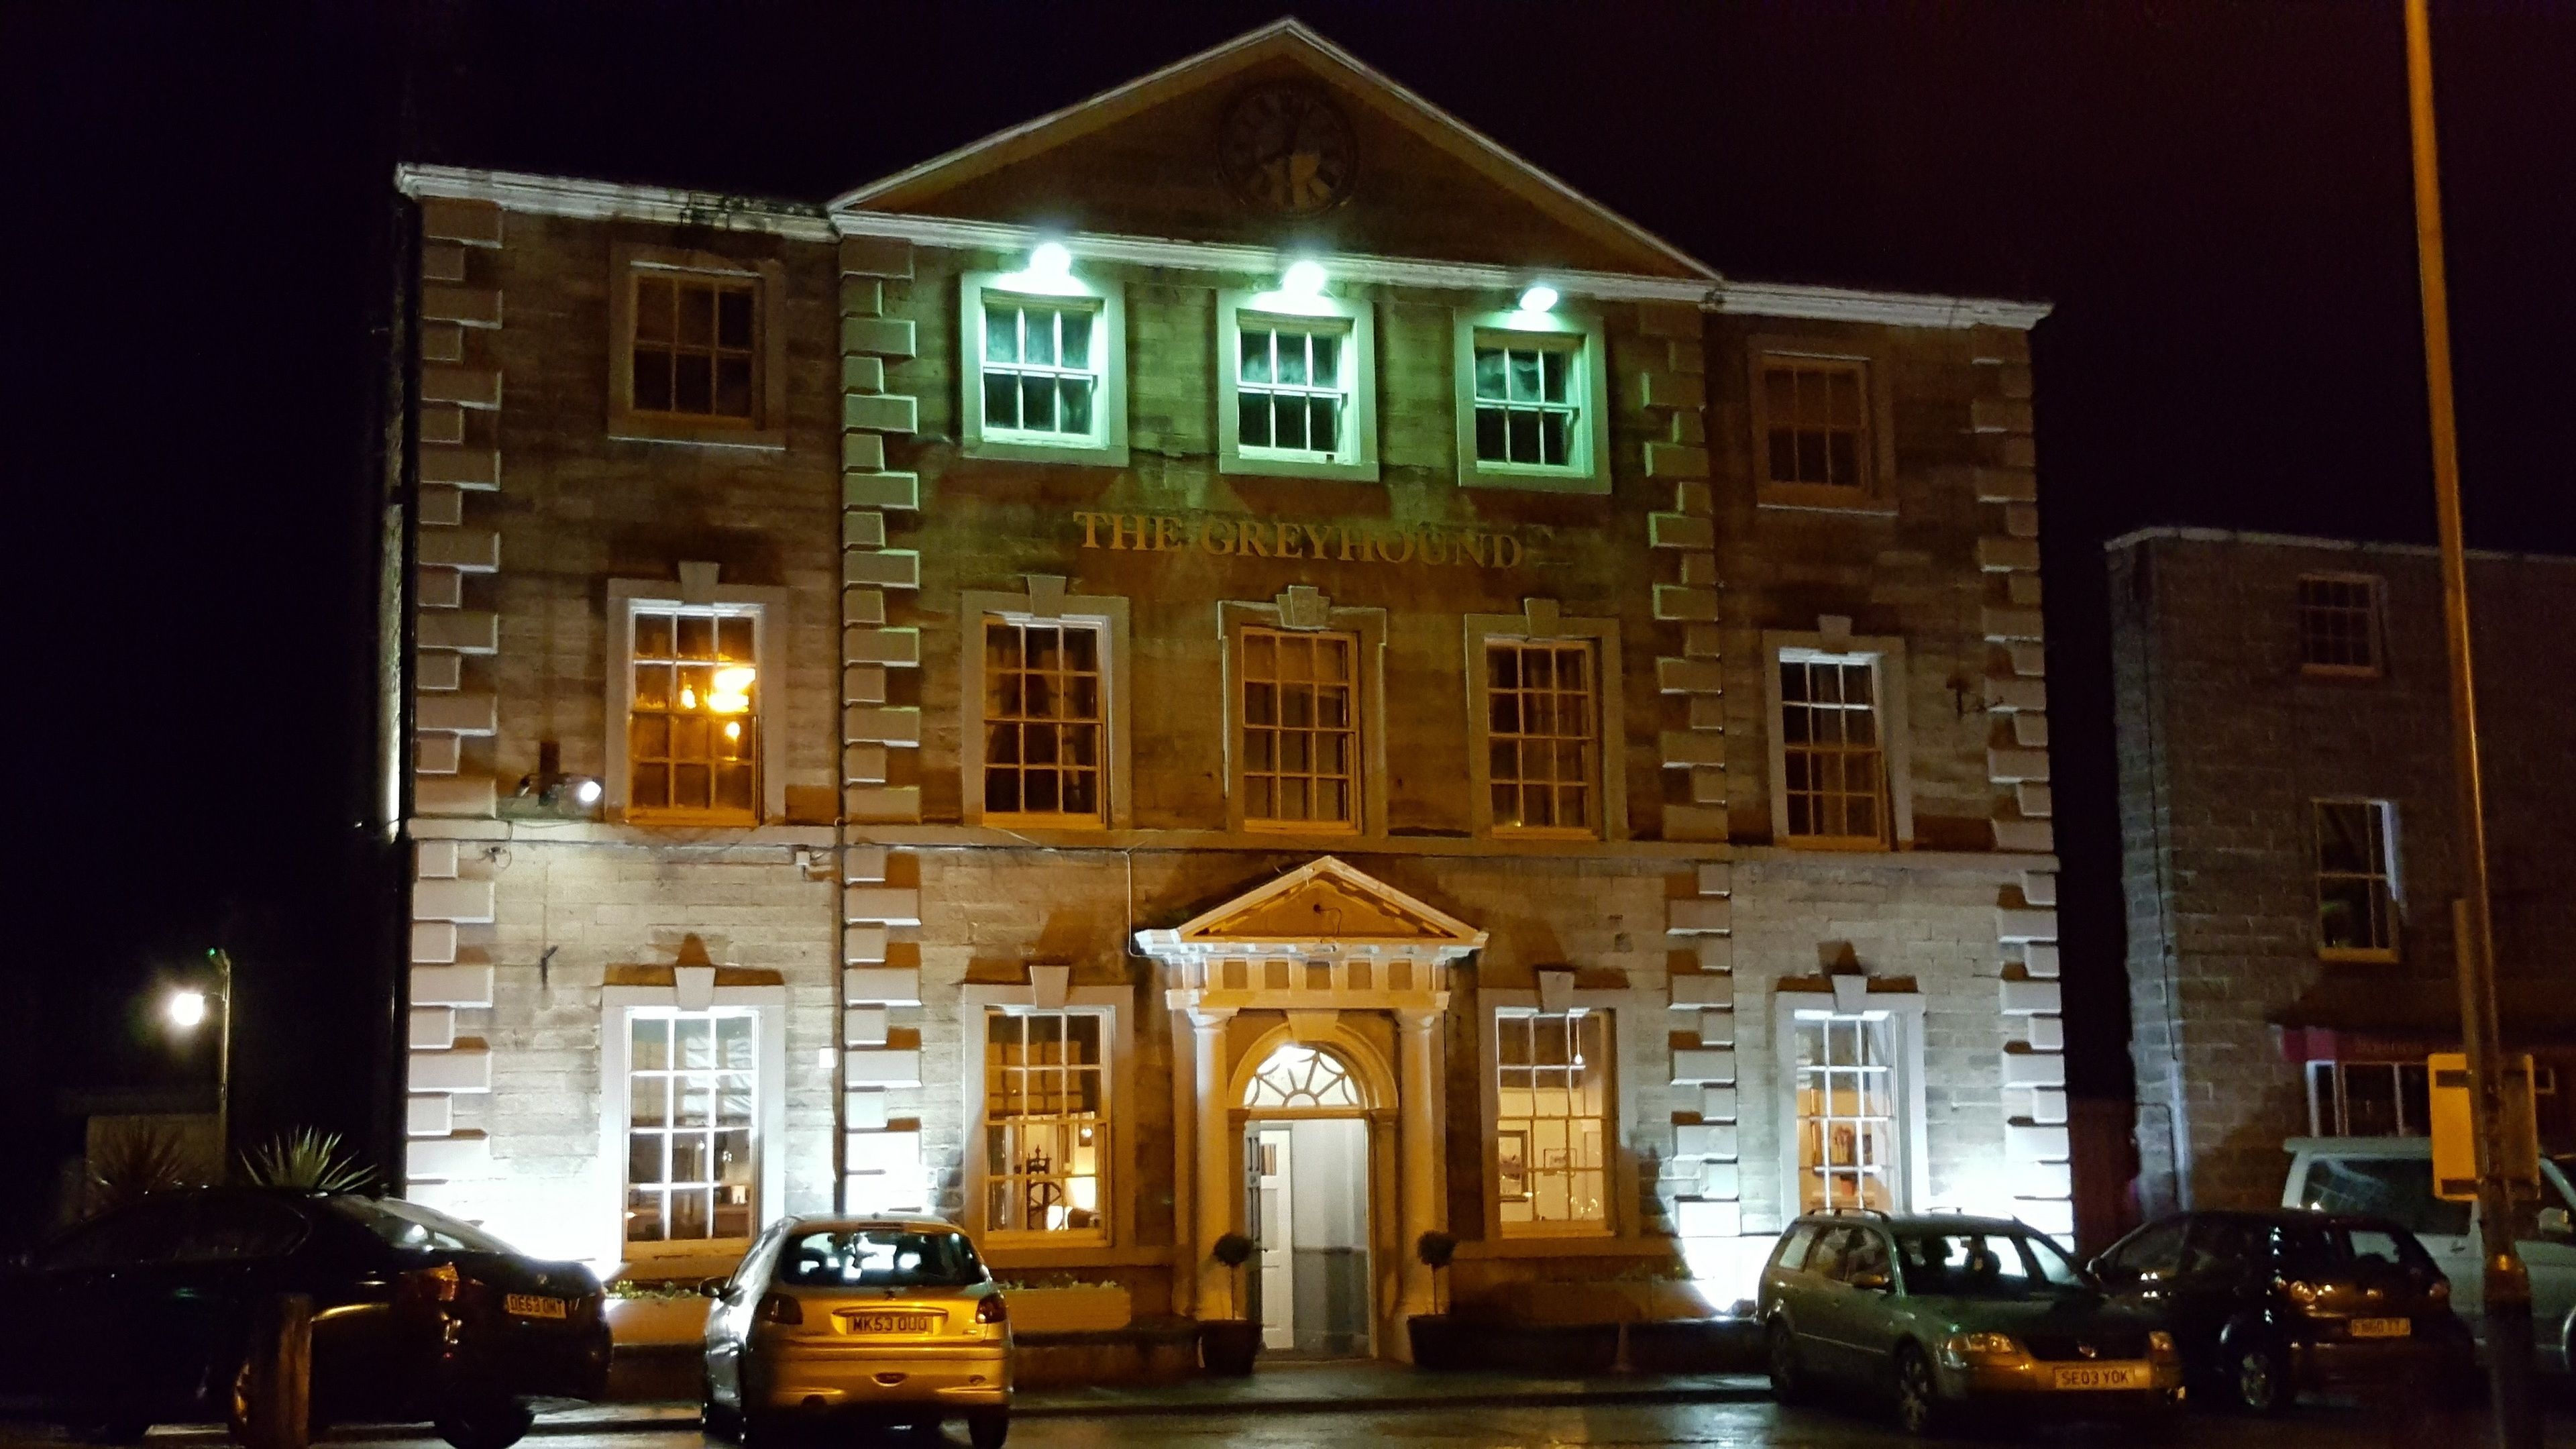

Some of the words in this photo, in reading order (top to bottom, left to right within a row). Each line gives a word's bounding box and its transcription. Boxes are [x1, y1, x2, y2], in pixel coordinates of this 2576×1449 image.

[1073, 511, 1183, 551] THE
[1201, 515, 1523, 569] GREYHOUND
[853, 1316, 893, 1332] MK53
[2061, 1370, 2099, 1385] SE03
[2102, 1369, 2129, 1385] YOK
